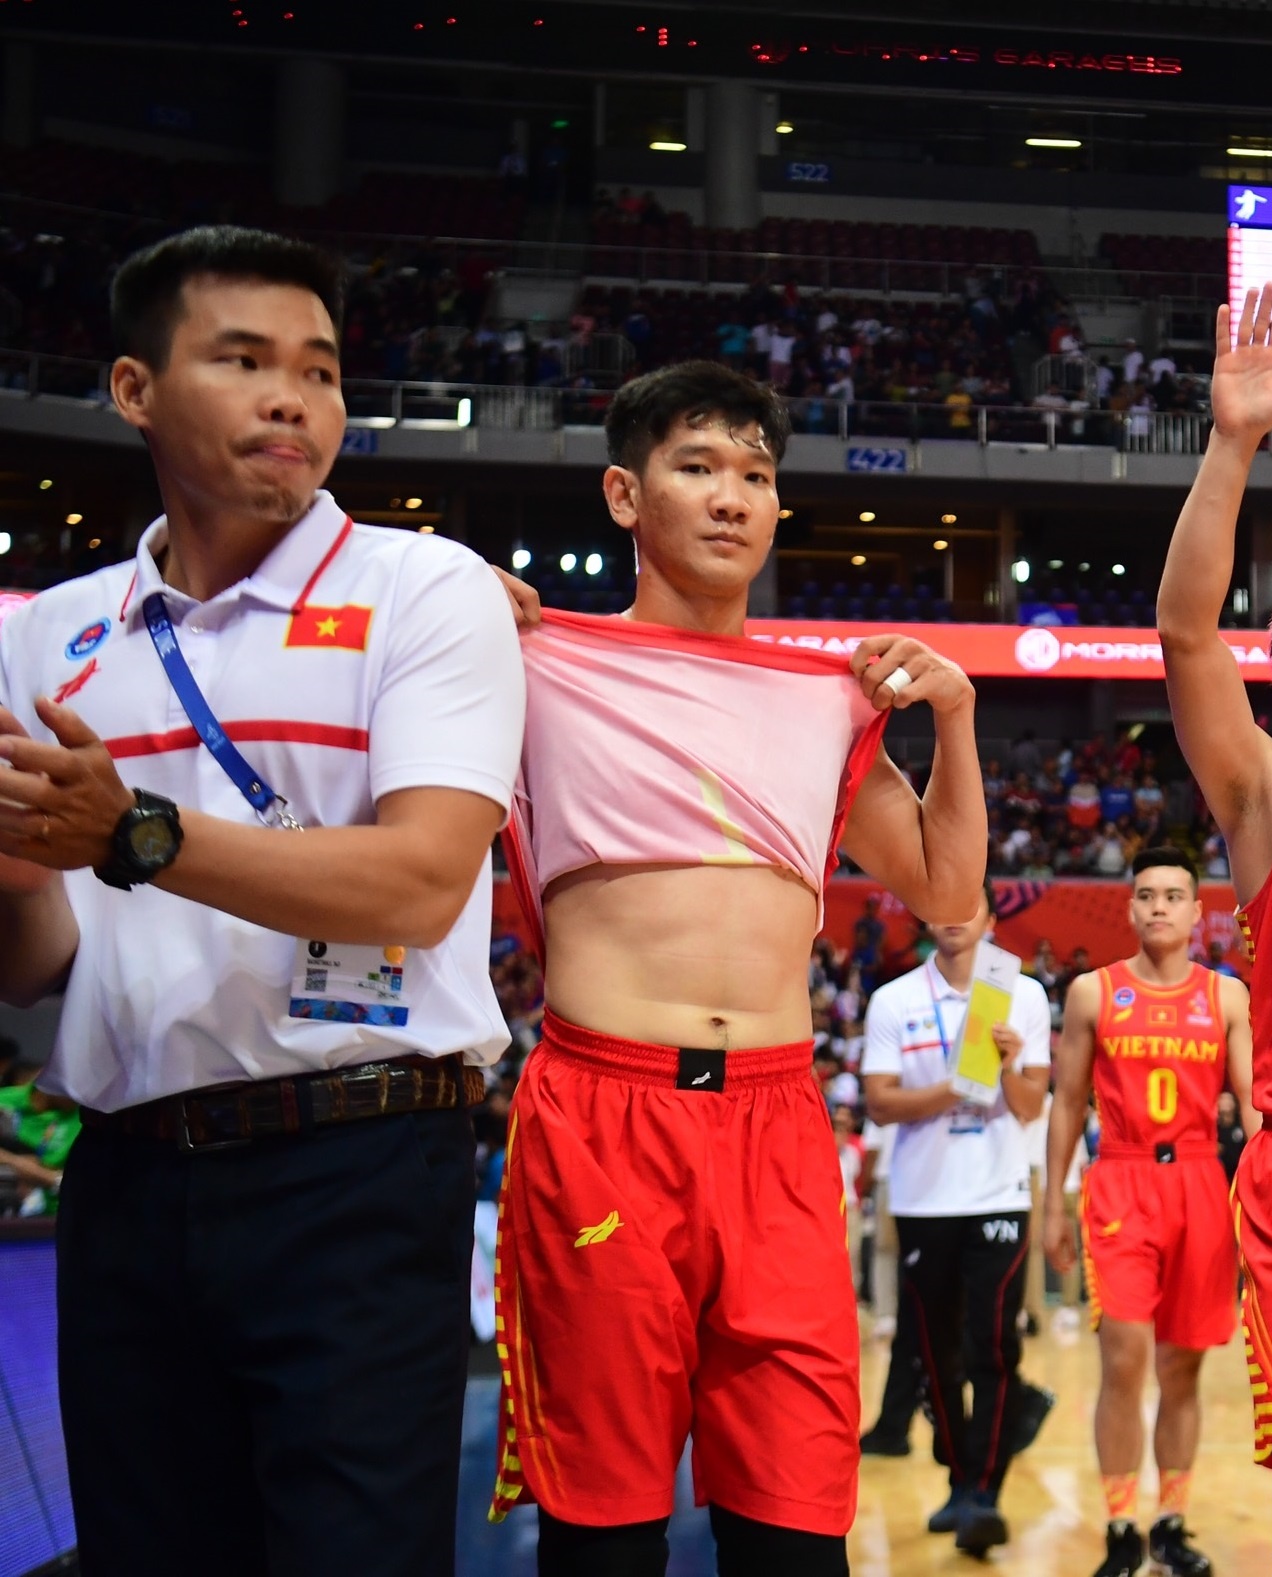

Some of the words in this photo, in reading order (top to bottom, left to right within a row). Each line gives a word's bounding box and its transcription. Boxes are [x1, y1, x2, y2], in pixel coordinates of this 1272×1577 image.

[791, 162, 829, 182] 522
[344, 428, 371, 454] 21
[851, 447, 903, 472] 422
[1061, 642, 1163, 662] MORR
[1103, 1034, 1219, 1063] VIETNAM
[1147, 1067, 1178, 1124] 0
[982, 1219, 1019, 1243] VN
